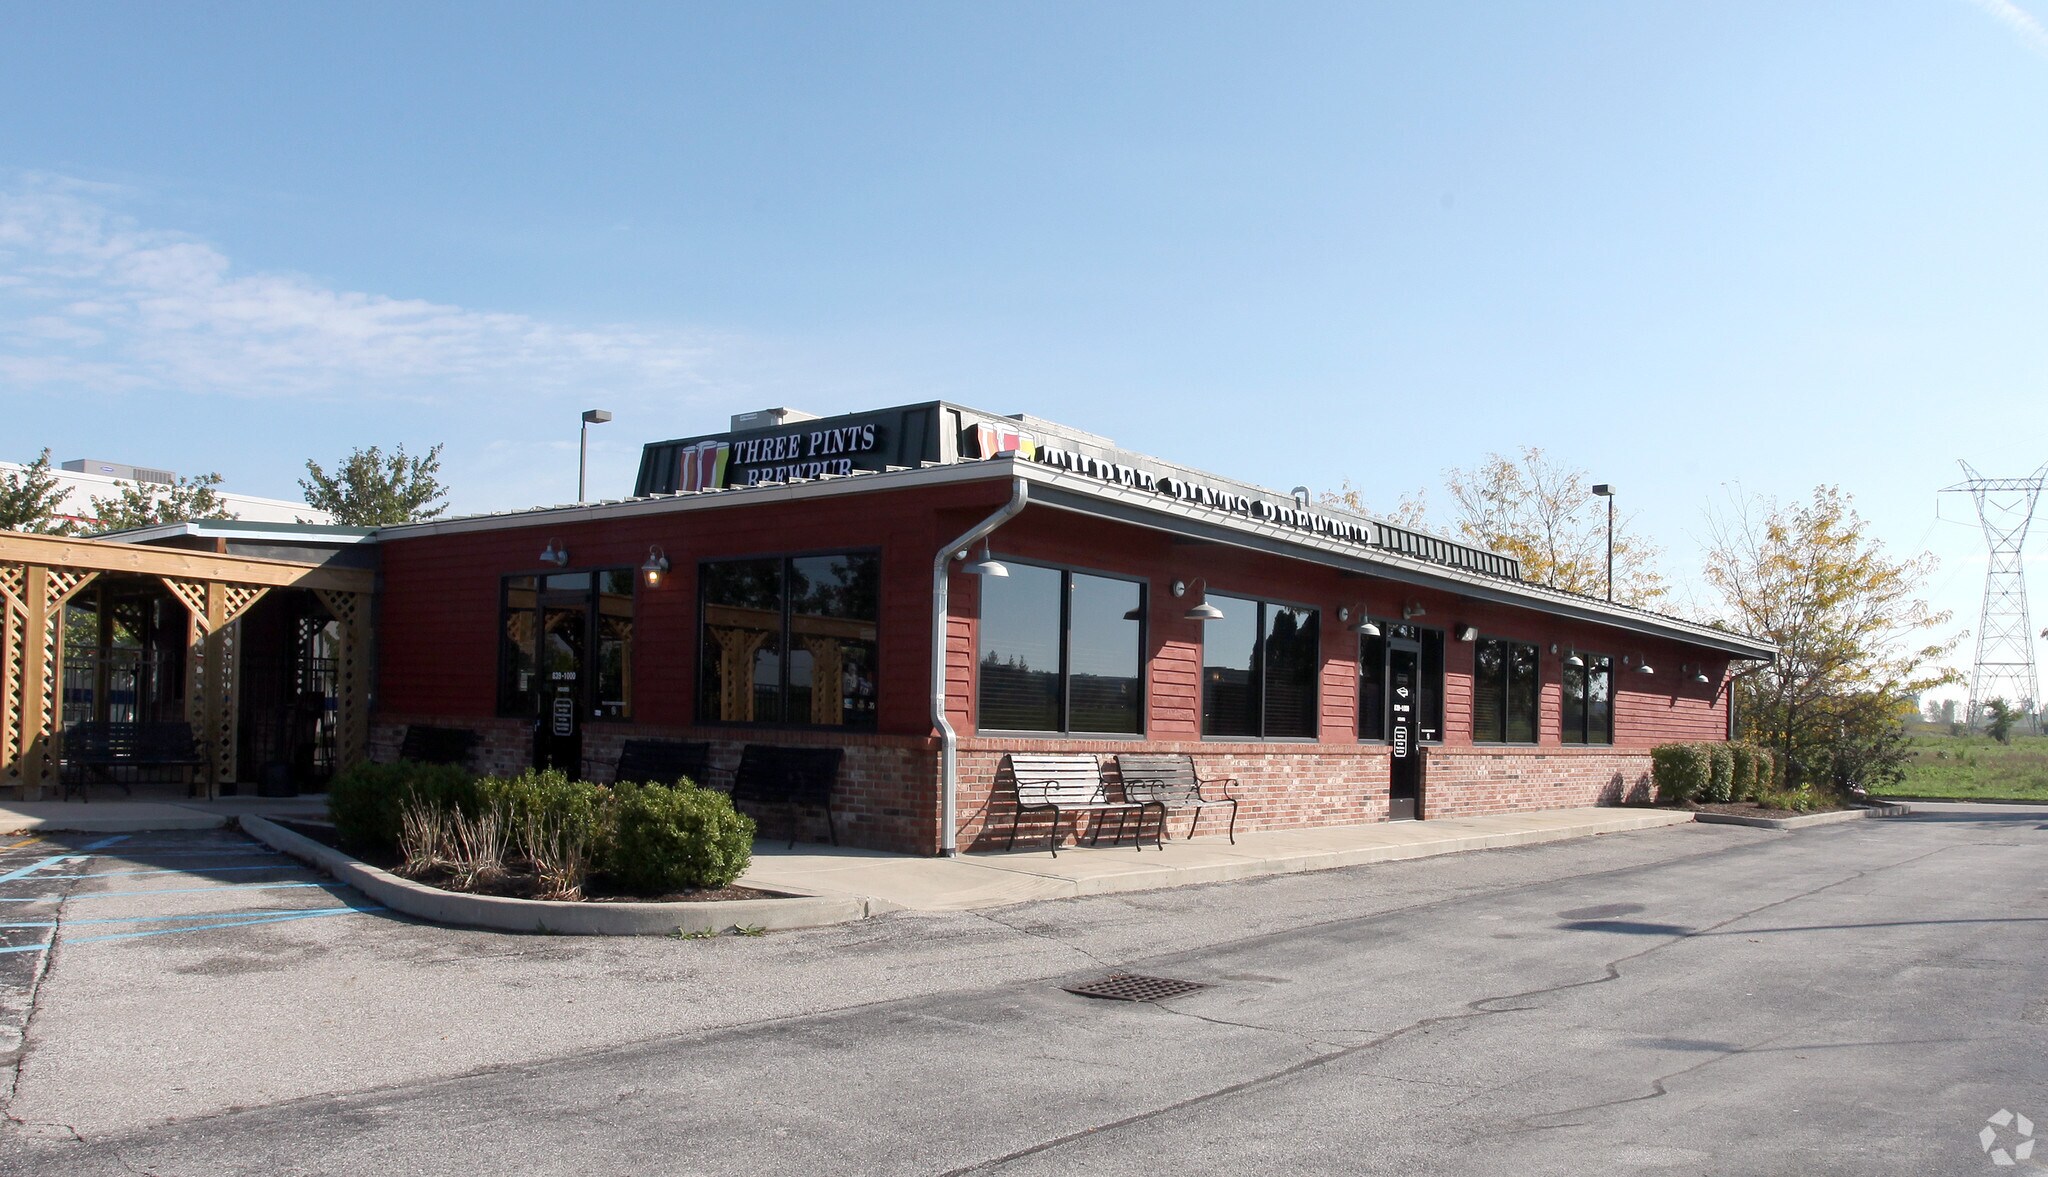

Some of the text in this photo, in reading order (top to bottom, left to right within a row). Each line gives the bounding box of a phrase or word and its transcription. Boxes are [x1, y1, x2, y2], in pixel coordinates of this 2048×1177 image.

[734, 423, 876, 465] THREE PINTS
[747, 458, 852, 487] BREWPUB
